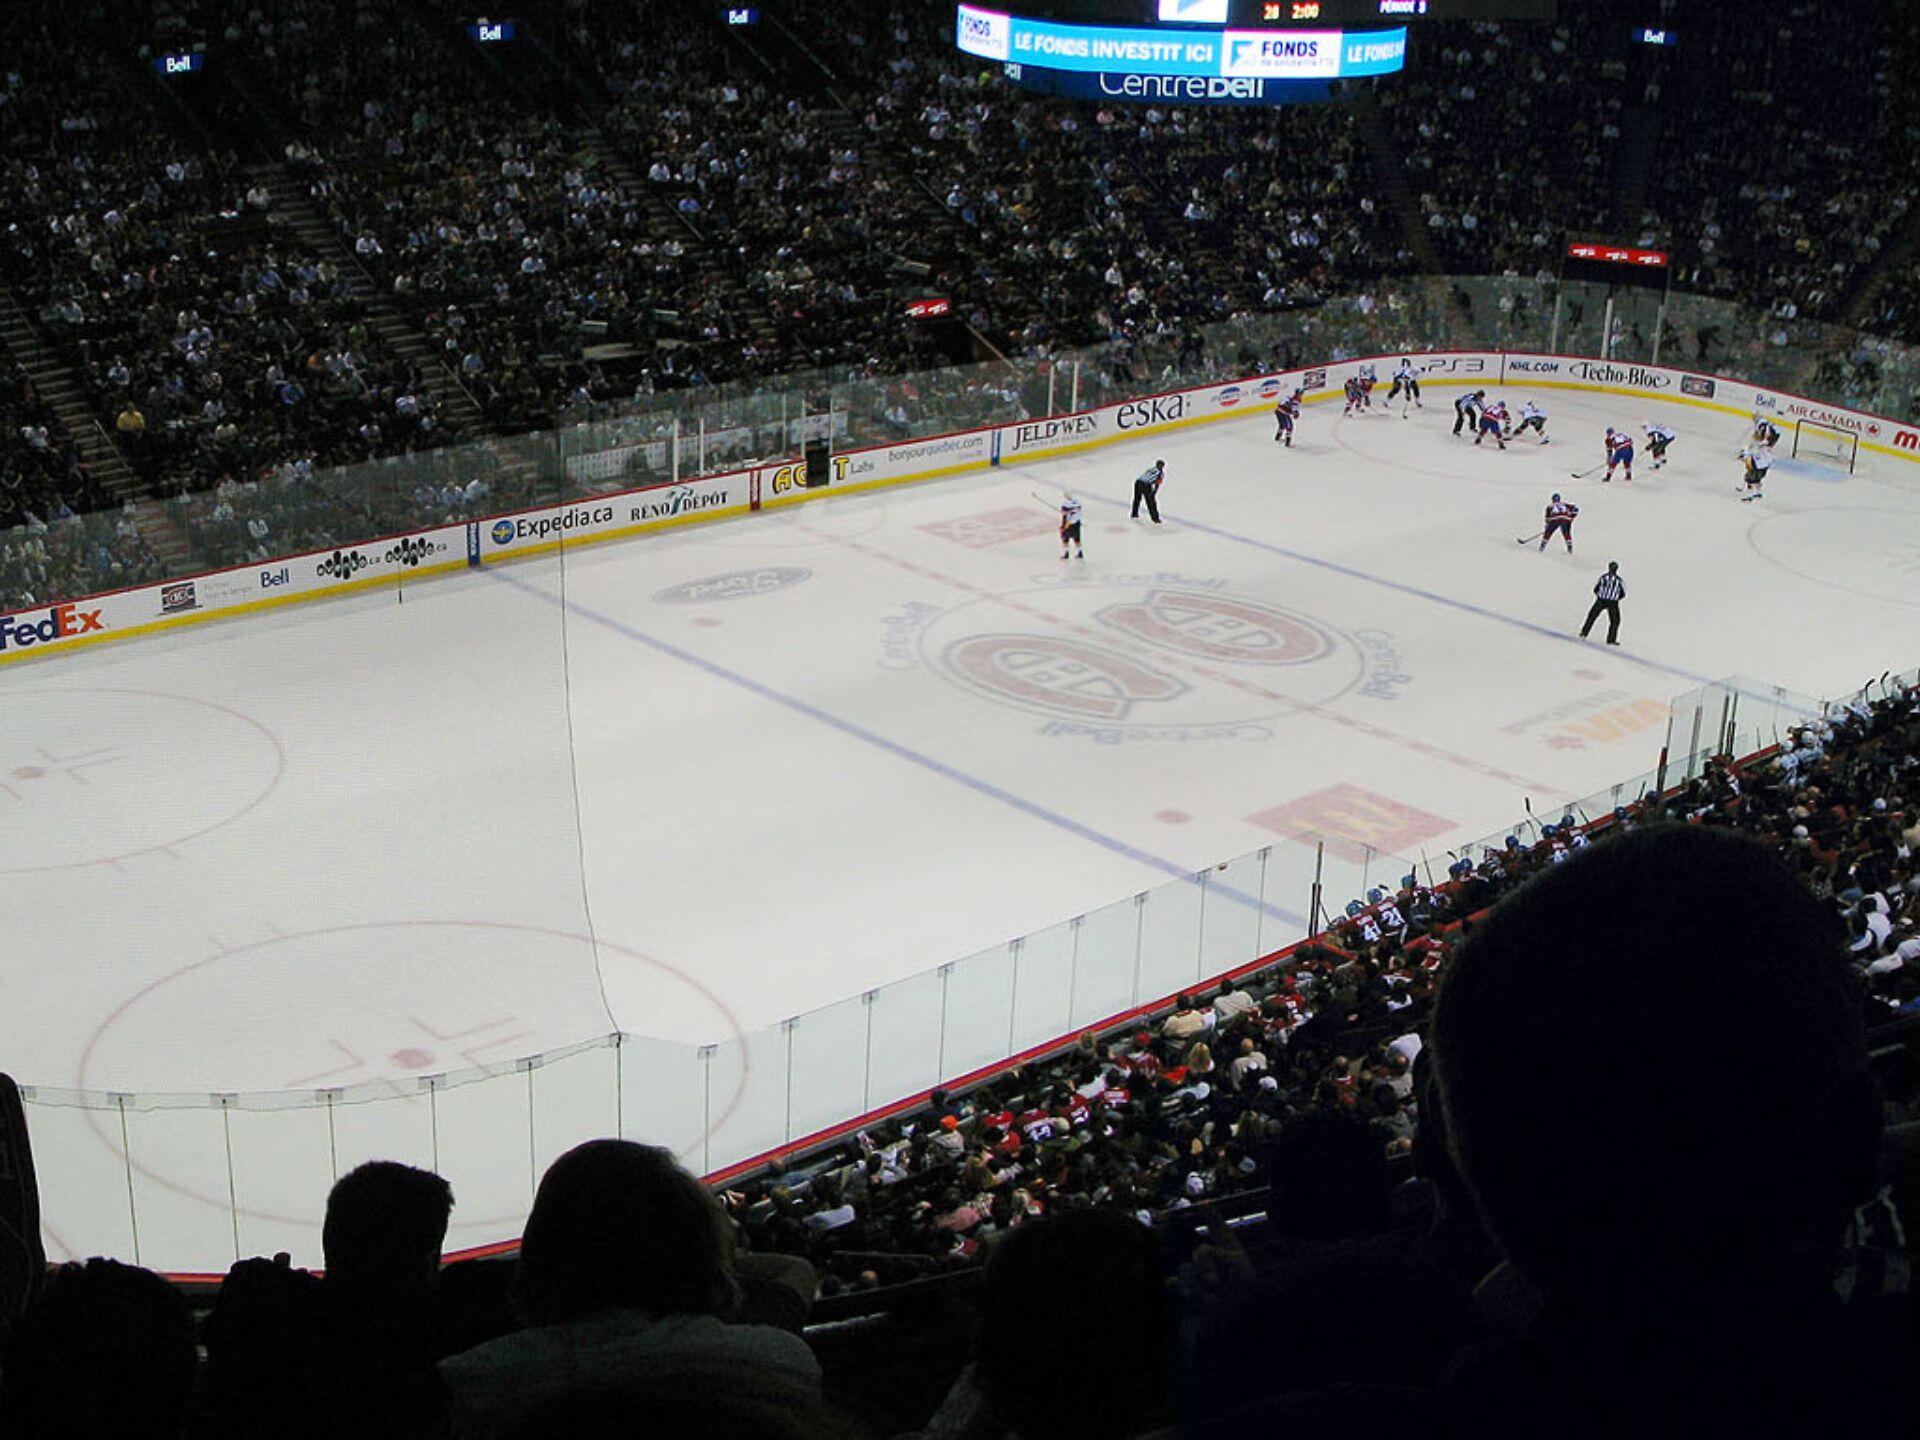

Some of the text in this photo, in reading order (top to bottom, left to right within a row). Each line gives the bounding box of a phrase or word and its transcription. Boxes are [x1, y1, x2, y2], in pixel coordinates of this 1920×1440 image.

[479, 24, 501, 40] Bell
[1014, 32, 1033, 50] LE
[1034, 34, 1089, 57] FONDS
[1093, 39, 1184, 61] INVESTIT
[1186, 44, 1213, 62] ICI
[1260, 40, 1318, 57] FONDS
[166, 55, 190, 72] Bell
[1509, 361, 1559, 373] NHL.COM
[1787, 404, 1863, 432] AIR CANADA
[516, 506, 613, 539] Expedia.ca
[260, 568, 290, 588] Bell
[0, 604, 105, 651] FedEx
